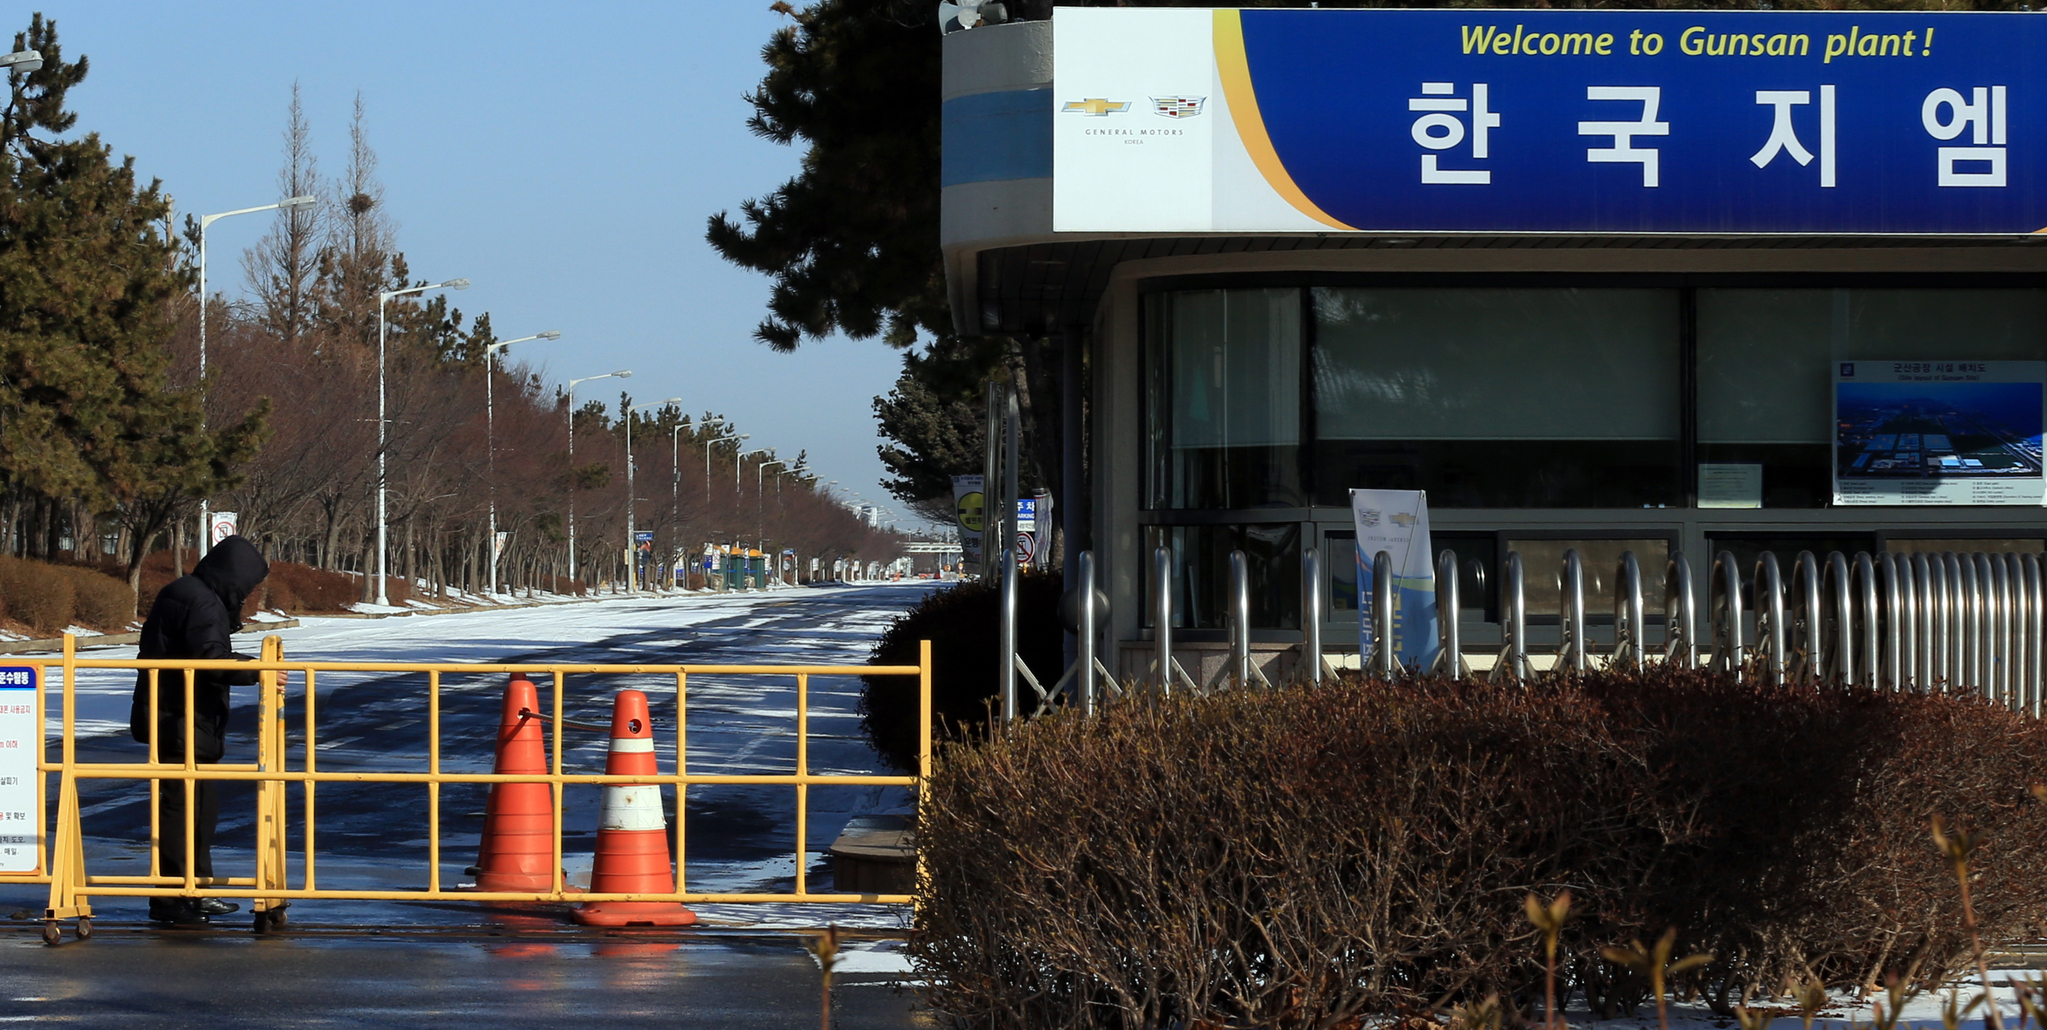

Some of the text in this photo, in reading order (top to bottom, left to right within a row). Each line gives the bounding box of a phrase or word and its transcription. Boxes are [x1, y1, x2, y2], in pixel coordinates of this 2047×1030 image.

[1461, 25, 1614, 54] Welcome
[1630, 29, 1664, 54] to
[1680, 26, 1809, 55] Gunsan
[1408, 82, 2007, 188] 한국지엠
[1894, 363, 1986, 373] 군산공장 시설 배치도
[6, 740, 18, 749] 이하
